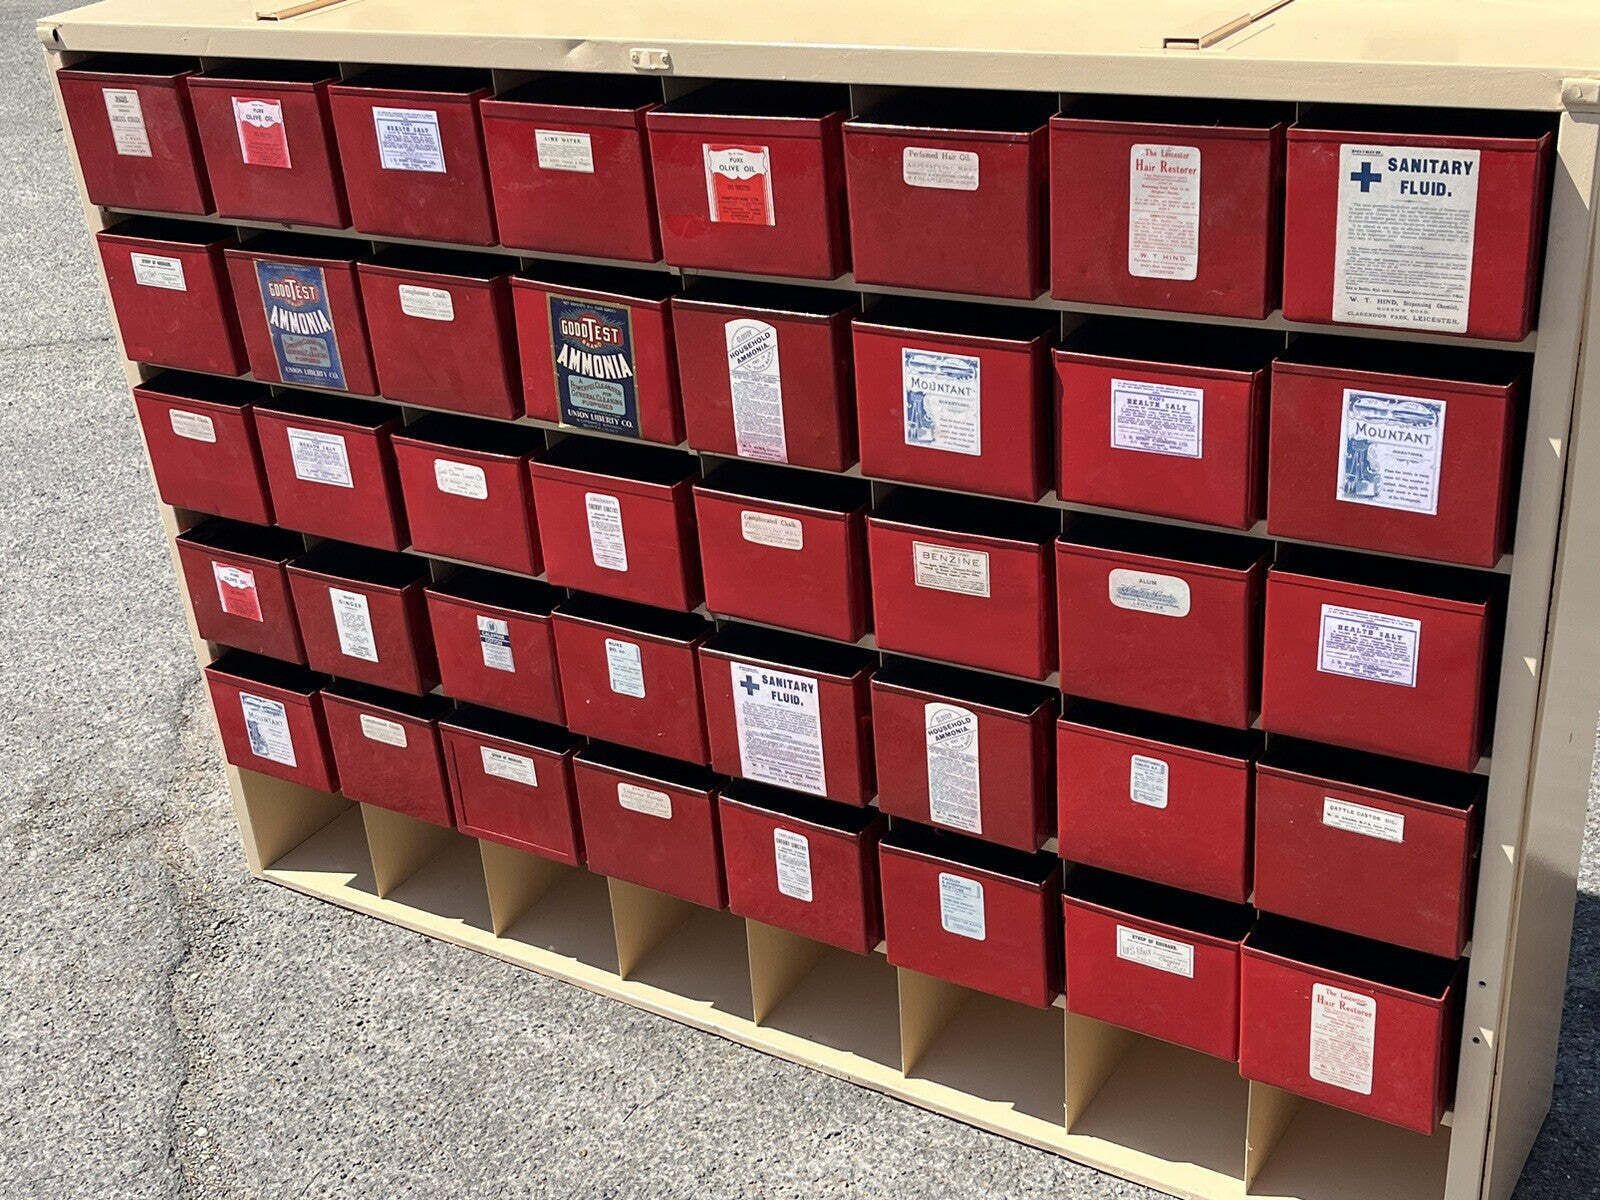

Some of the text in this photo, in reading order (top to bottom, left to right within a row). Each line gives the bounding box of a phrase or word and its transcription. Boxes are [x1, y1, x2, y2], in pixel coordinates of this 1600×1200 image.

[942, 152, 956, 161] Hair
[719, 164, 739, 172] OLIVE
[1136, 159, 1197, 175] Hair Restorer
[1387, 157, 1474, 176] SANITARY
[1400, 180, 1453, 198] FLUID.
[268, 279, 316, 301] GOODTEST
[270, 305, 332, 335] AMMONIA
[561, 317, 619, 344] GOODTEST
[730, 332, 771, 360] HOUSEHOLD
[557, 344, 633, 380] AMMONIA
[911, 377, 972, 396] MOUNTANT
[568, 408, 589, 420] UNION
[590, 412, 620, 425] LIBERTY
[1356, 422, 1432, 445] MOUNTANT
[922, 551, 980, 568] BENZINE
[1139, 578, 1157, 586] ALUM
[762, 674, 815, 693] SANITARY
[772, 691, 804, 706] FLUID.
[928, 717, 971, 736] HOUSEHOLD
[1329, 804, 1354, 815] CATTLE
[1357, 811, 1381, 822] CASTOR
[1317, 994, 1373, 1018] Hair Restorer
